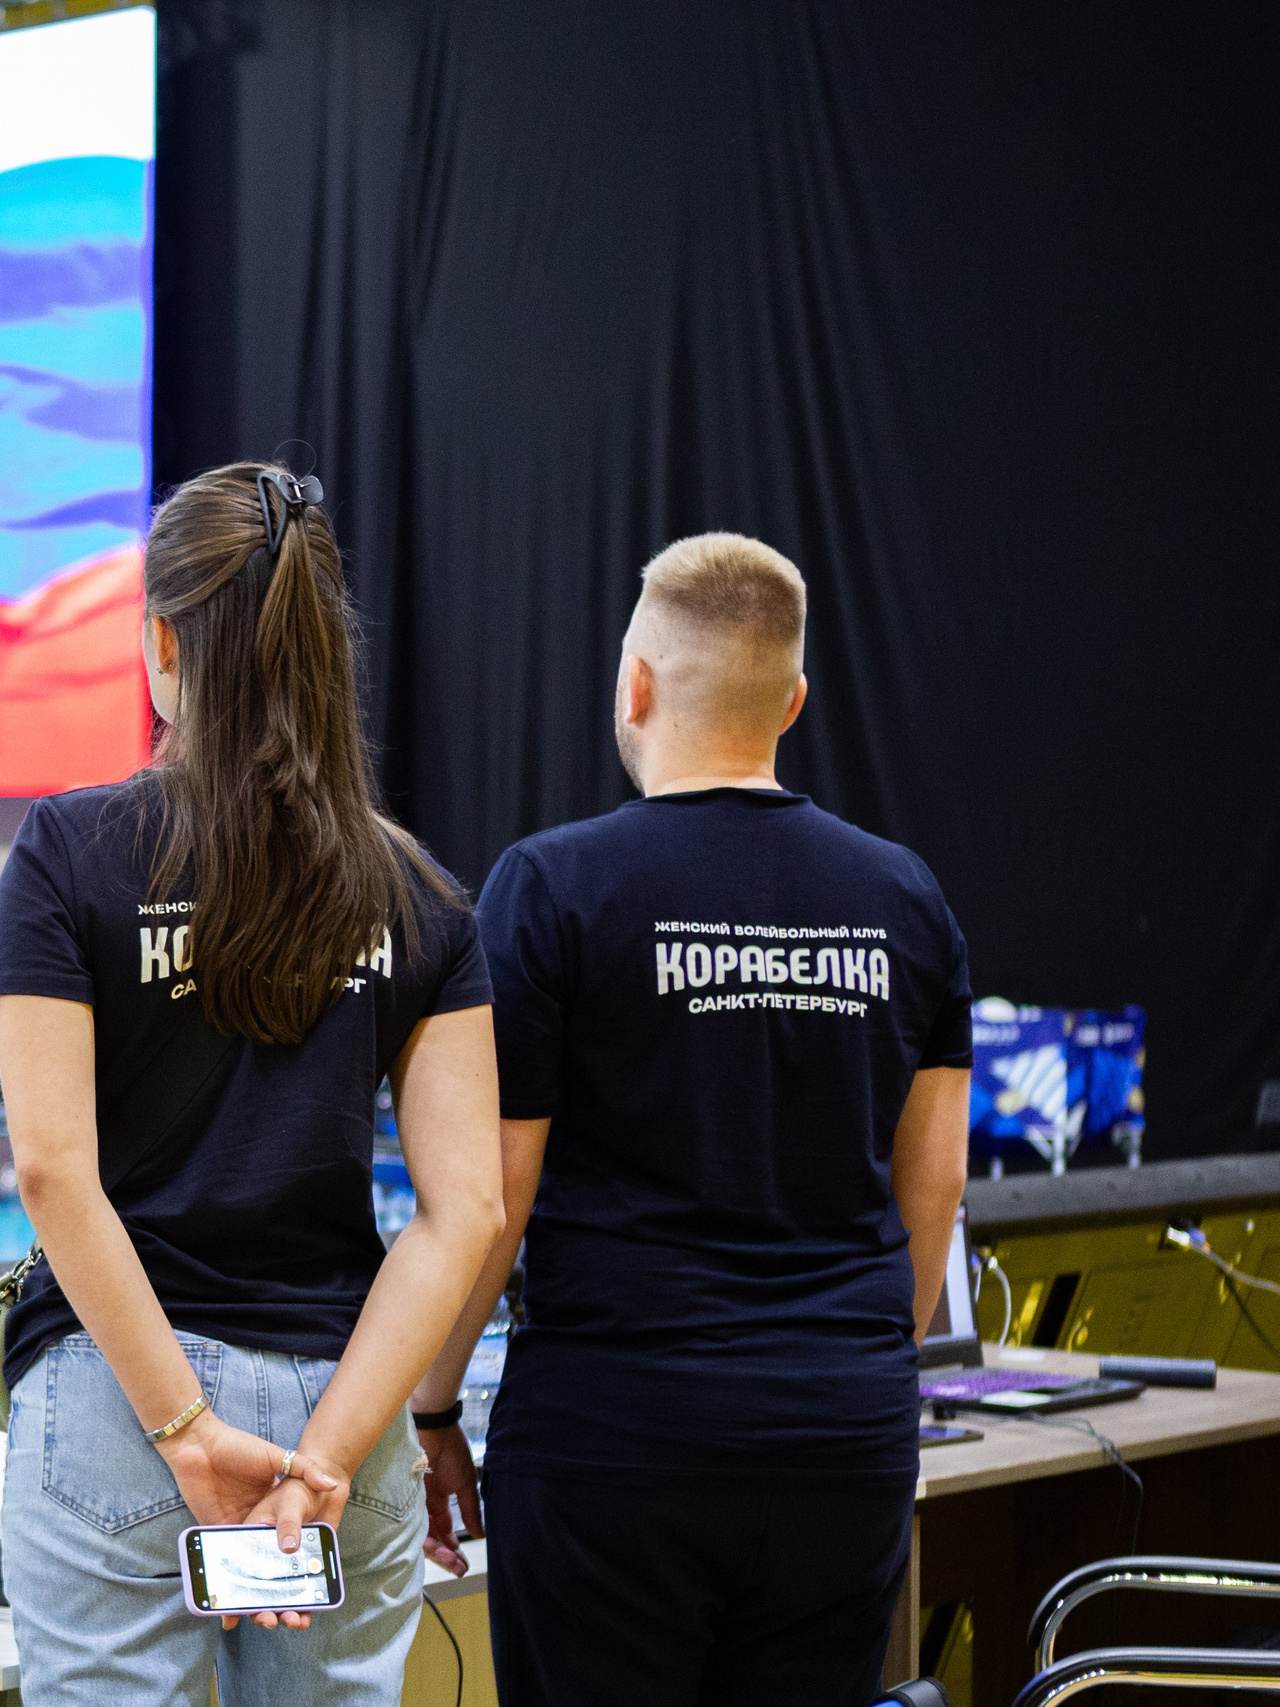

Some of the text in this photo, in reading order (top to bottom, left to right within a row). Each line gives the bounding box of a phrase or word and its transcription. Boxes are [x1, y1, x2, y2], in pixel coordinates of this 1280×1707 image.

[654, 921, 888, 940] ЖЕНСКИЙ ВОЛЕЙБОЛЬНЫЙ КЛУБ
[655, 942, 890, 1001] КОРАБЕЛКА
